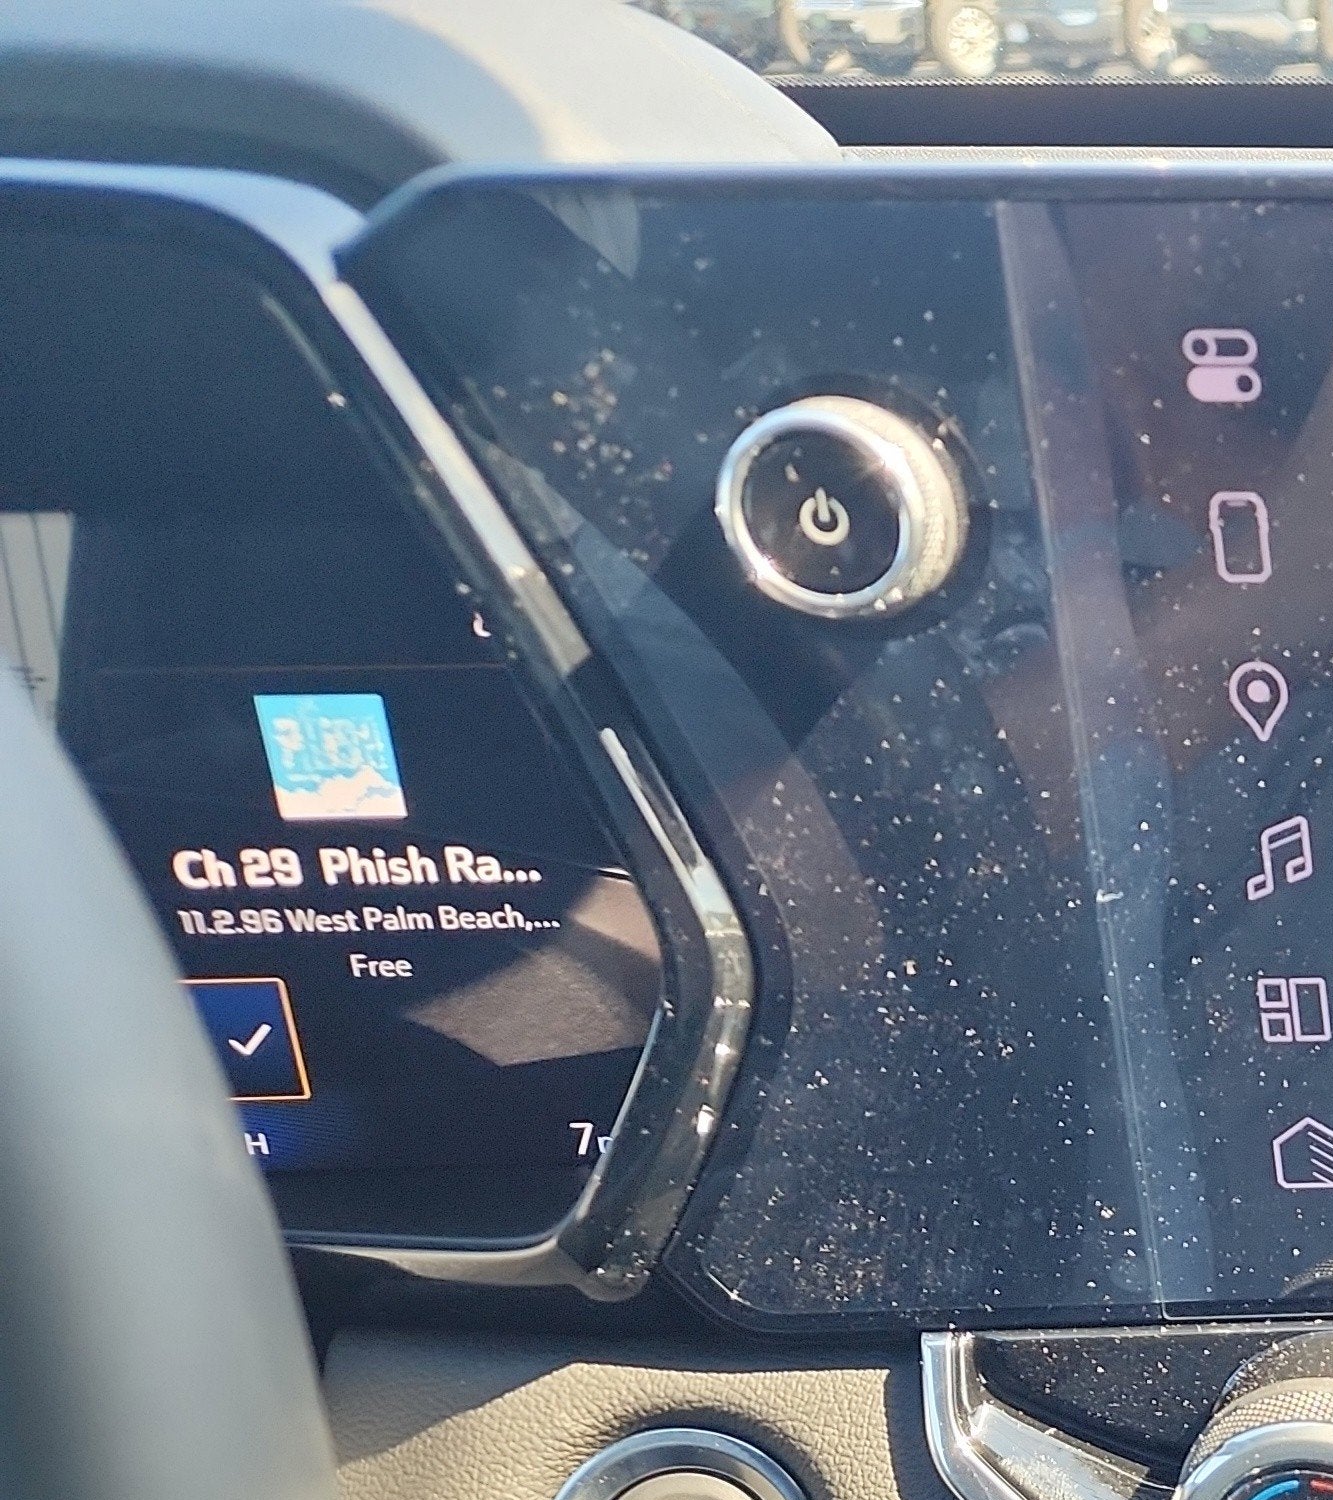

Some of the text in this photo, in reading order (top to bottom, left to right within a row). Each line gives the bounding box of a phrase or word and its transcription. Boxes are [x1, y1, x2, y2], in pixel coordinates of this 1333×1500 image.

[173, 848, 237, 890] Ch
[240, 847, 304, 888] 29
[319, 845, 439, 887] Phish
[177, 908, 285, 935] 11.2.96
[285, 906, 361, 933] West
[362, 905, 434, 932] Palm
[349, 953, 414, 978] Free
